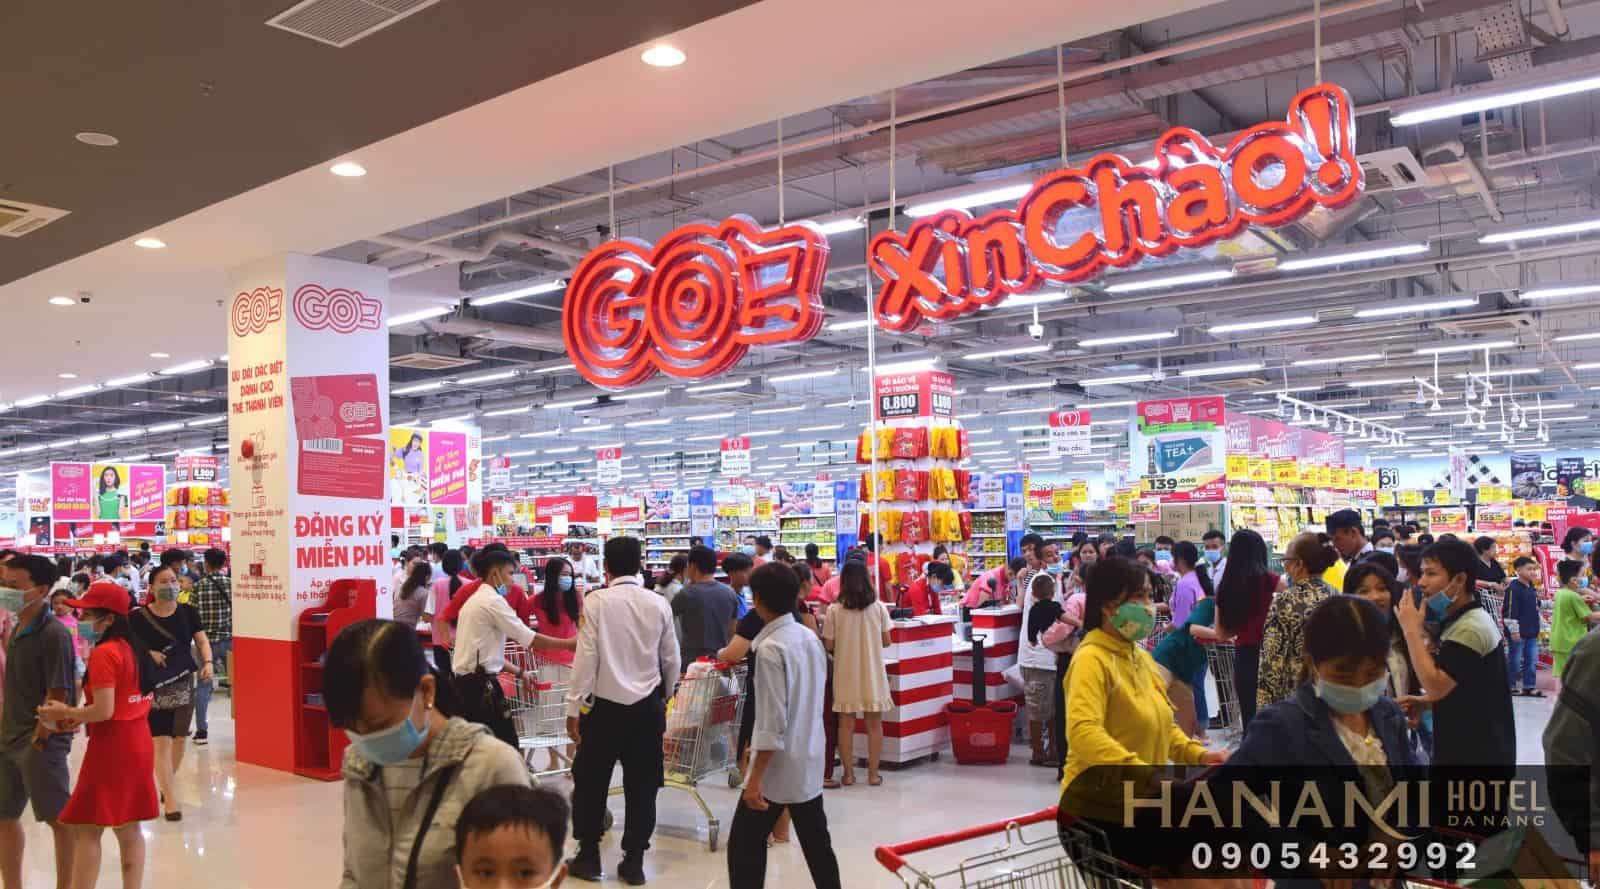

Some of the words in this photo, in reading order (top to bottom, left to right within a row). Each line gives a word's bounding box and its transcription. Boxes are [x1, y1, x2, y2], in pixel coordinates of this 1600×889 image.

[260, 380, 274, 393] CHO
[294, 512, 353, 537] ĐĂNG
[358, 510, 384, 537] KÝ
[296, 538, 349, 569] MIỄN
[353, 540, 384, 566] PHÍ
[296, 591, 308, 602] hệ
